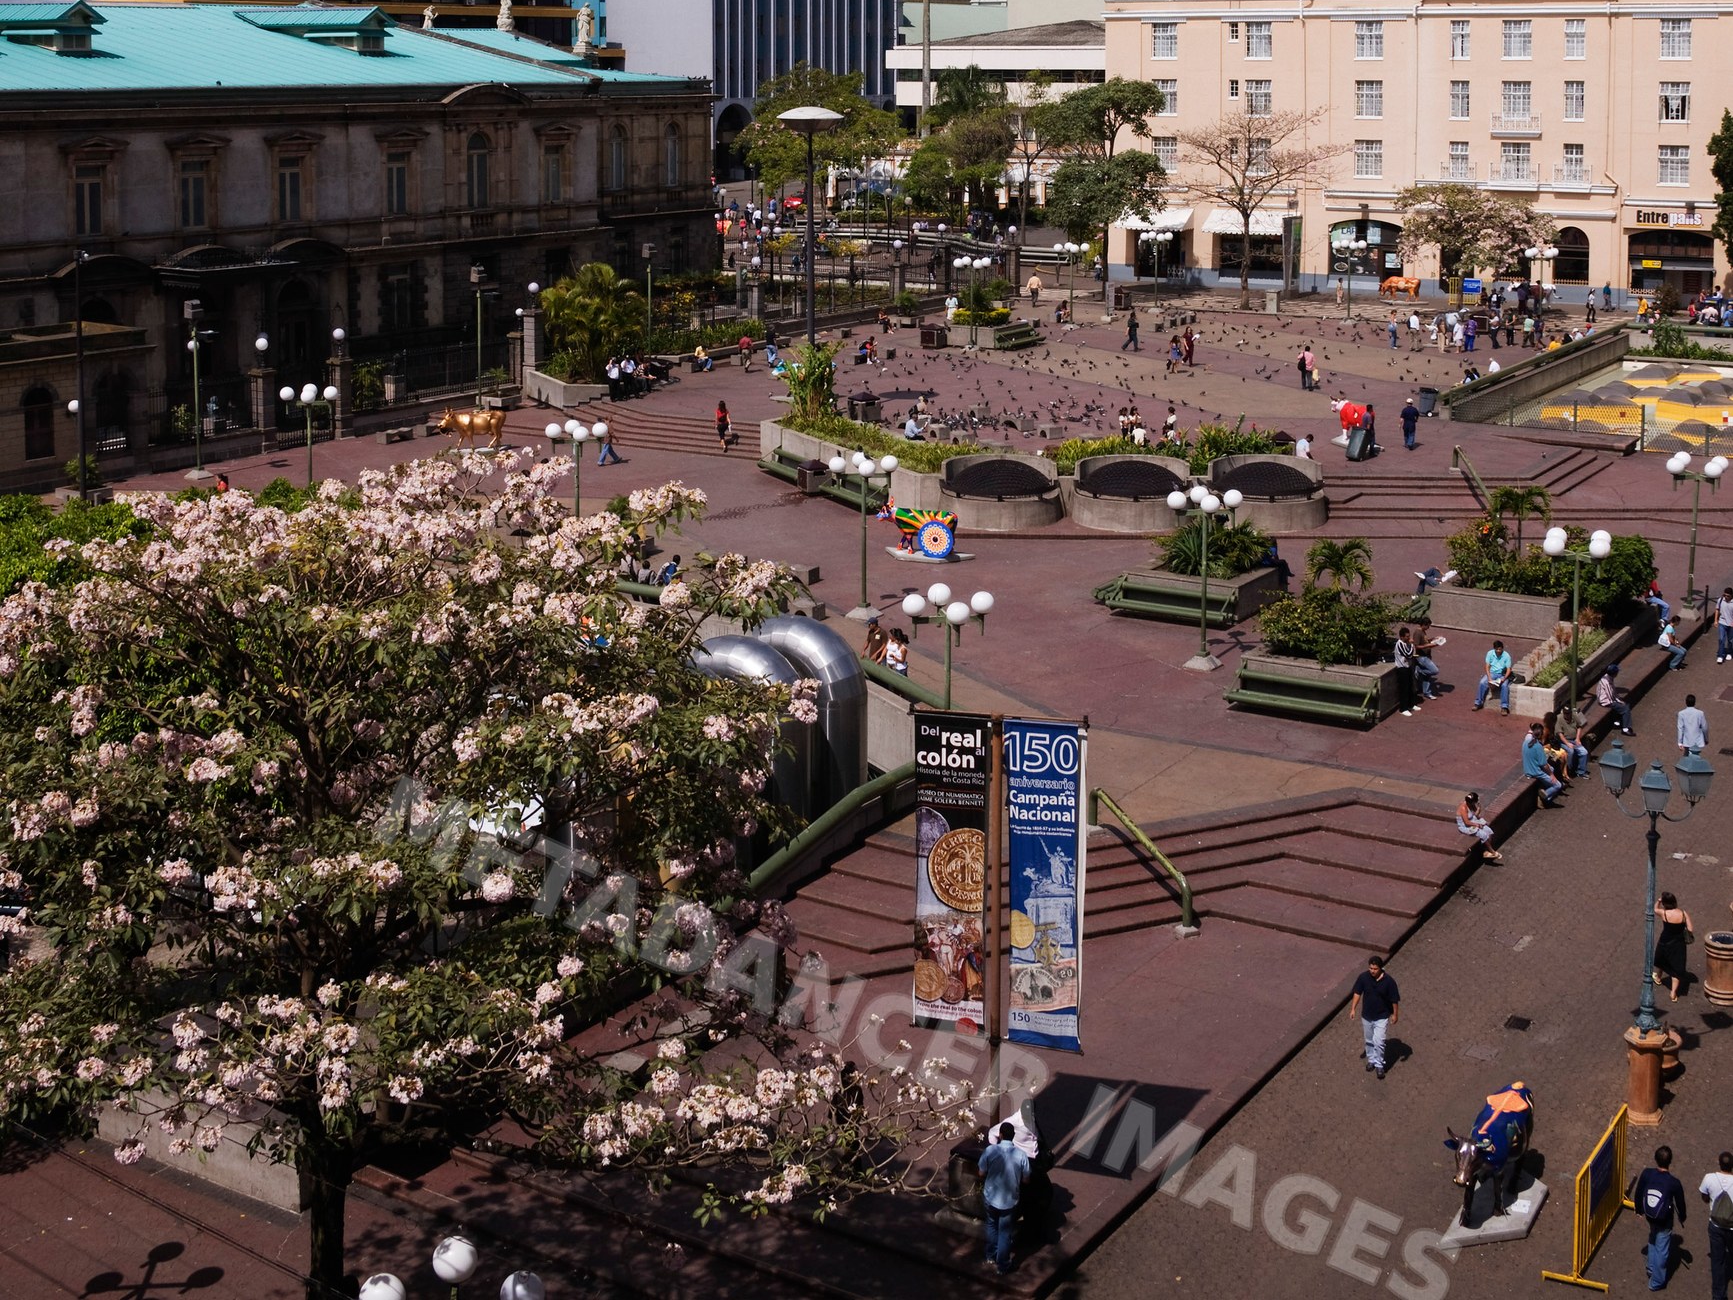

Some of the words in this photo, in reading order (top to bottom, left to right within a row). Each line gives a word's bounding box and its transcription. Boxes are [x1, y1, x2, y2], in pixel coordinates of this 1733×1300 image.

[921, 725, 940, 736] Del
[941, 729, 982, 748] real
[975, 746, 985, 756] al
[916, 747, 975, 769] colón
[1003, 731, 1079, 775] 150
[916, 767, 940, 776] Historia
[958, 771, 985, 779] moneda
[952, 777, 971, 785] Costa
[972, 778, 985, 786] Rica
[1009, 775, 1075, 790] aniversario
[1009, 789, 1075, 807] Campaña
[1009, 805, 1075, 823] Nacional
[1060, 969, 1073, 978] 20
[1012, 1012, 1031, 1023] 150
